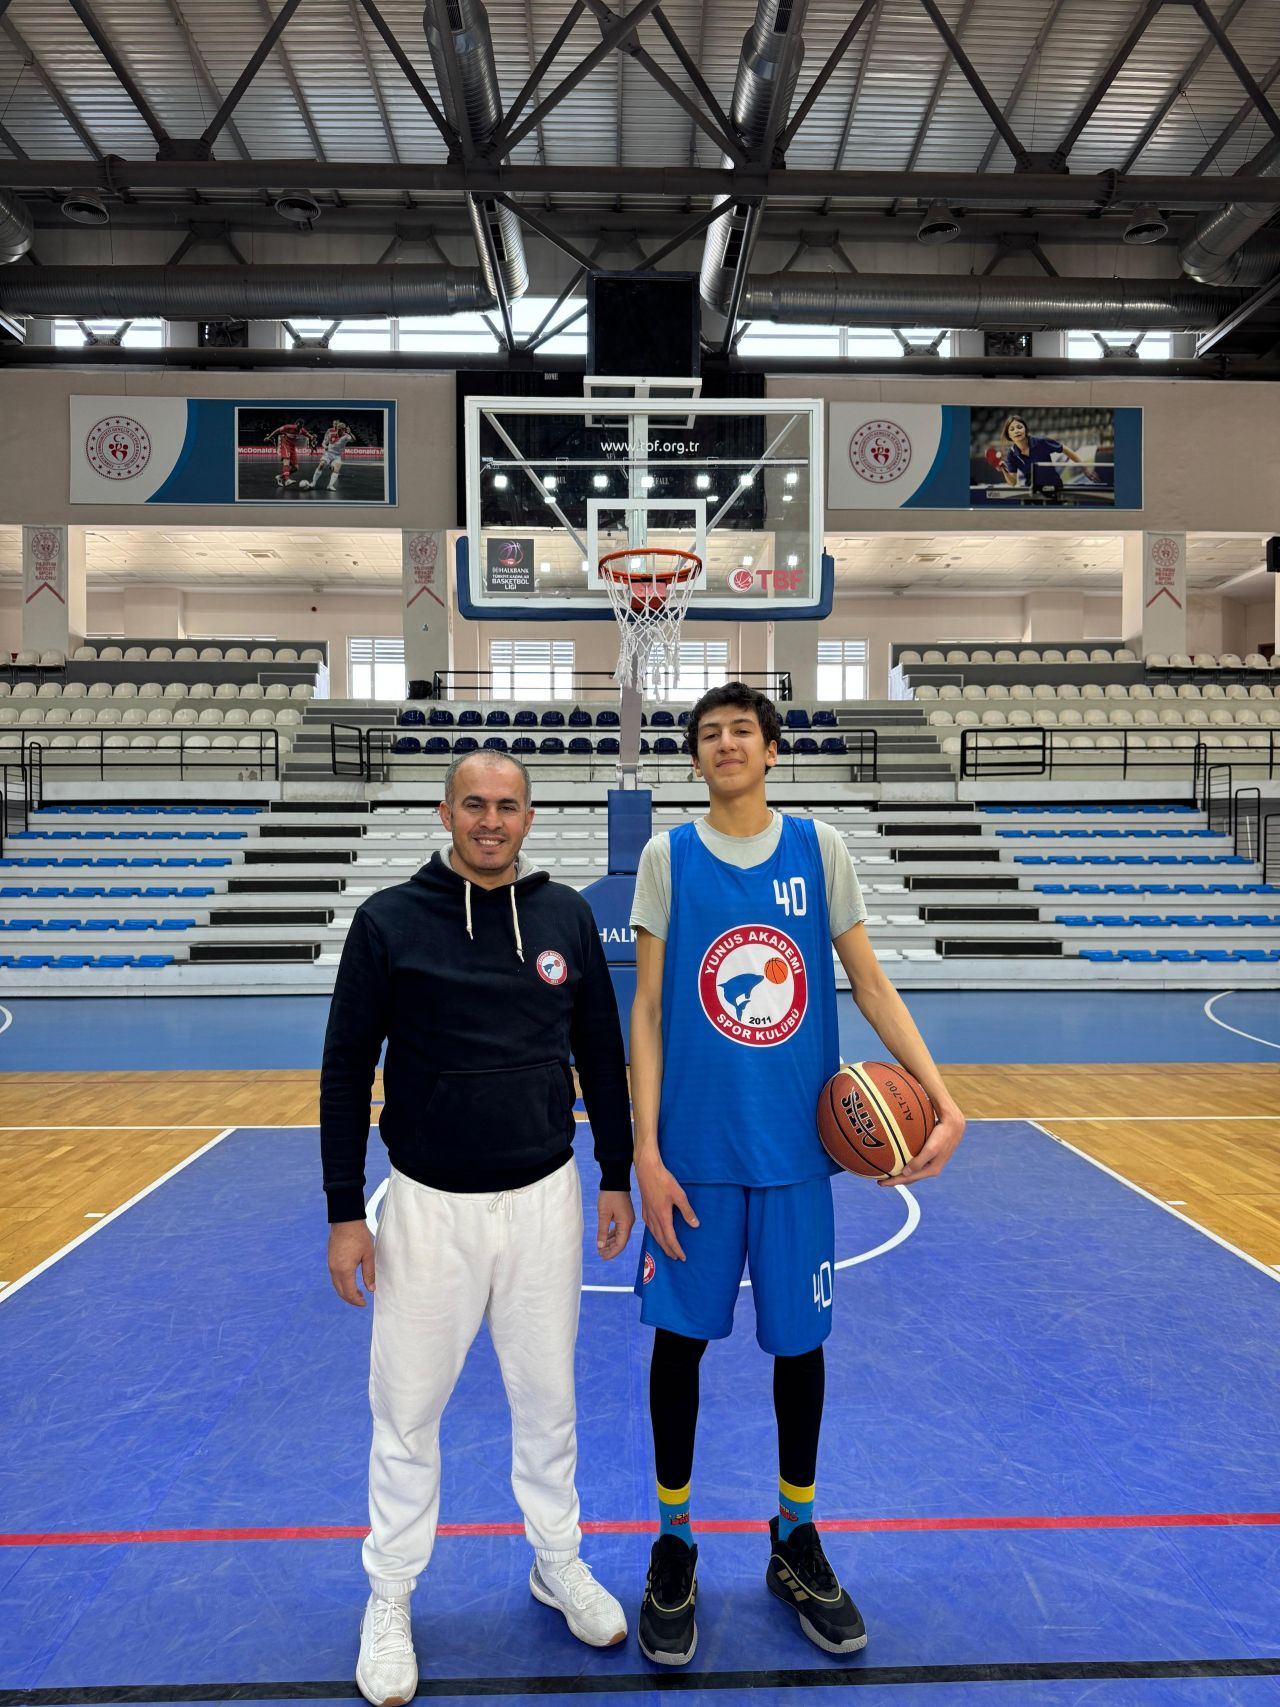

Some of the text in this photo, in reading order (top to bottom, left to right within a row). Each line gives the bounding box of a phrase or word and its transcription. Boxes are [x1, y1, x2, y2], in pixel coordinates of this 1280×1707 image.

[600, 440, 700, 454] www.tbf.org.tr
[756, 569, 804, 591] TBF
[773, 876, 806, 916] 40
[705, 931, 803, 974] YUNUS AKADEMİ
[717, 1008, 800, 1040] SPOR KULÜBÜ
[749, 1016, 772, 1025] 2011
[886, 1080, 914, 1121] ALT-700
[813, 1261, 832, 1312] 40
